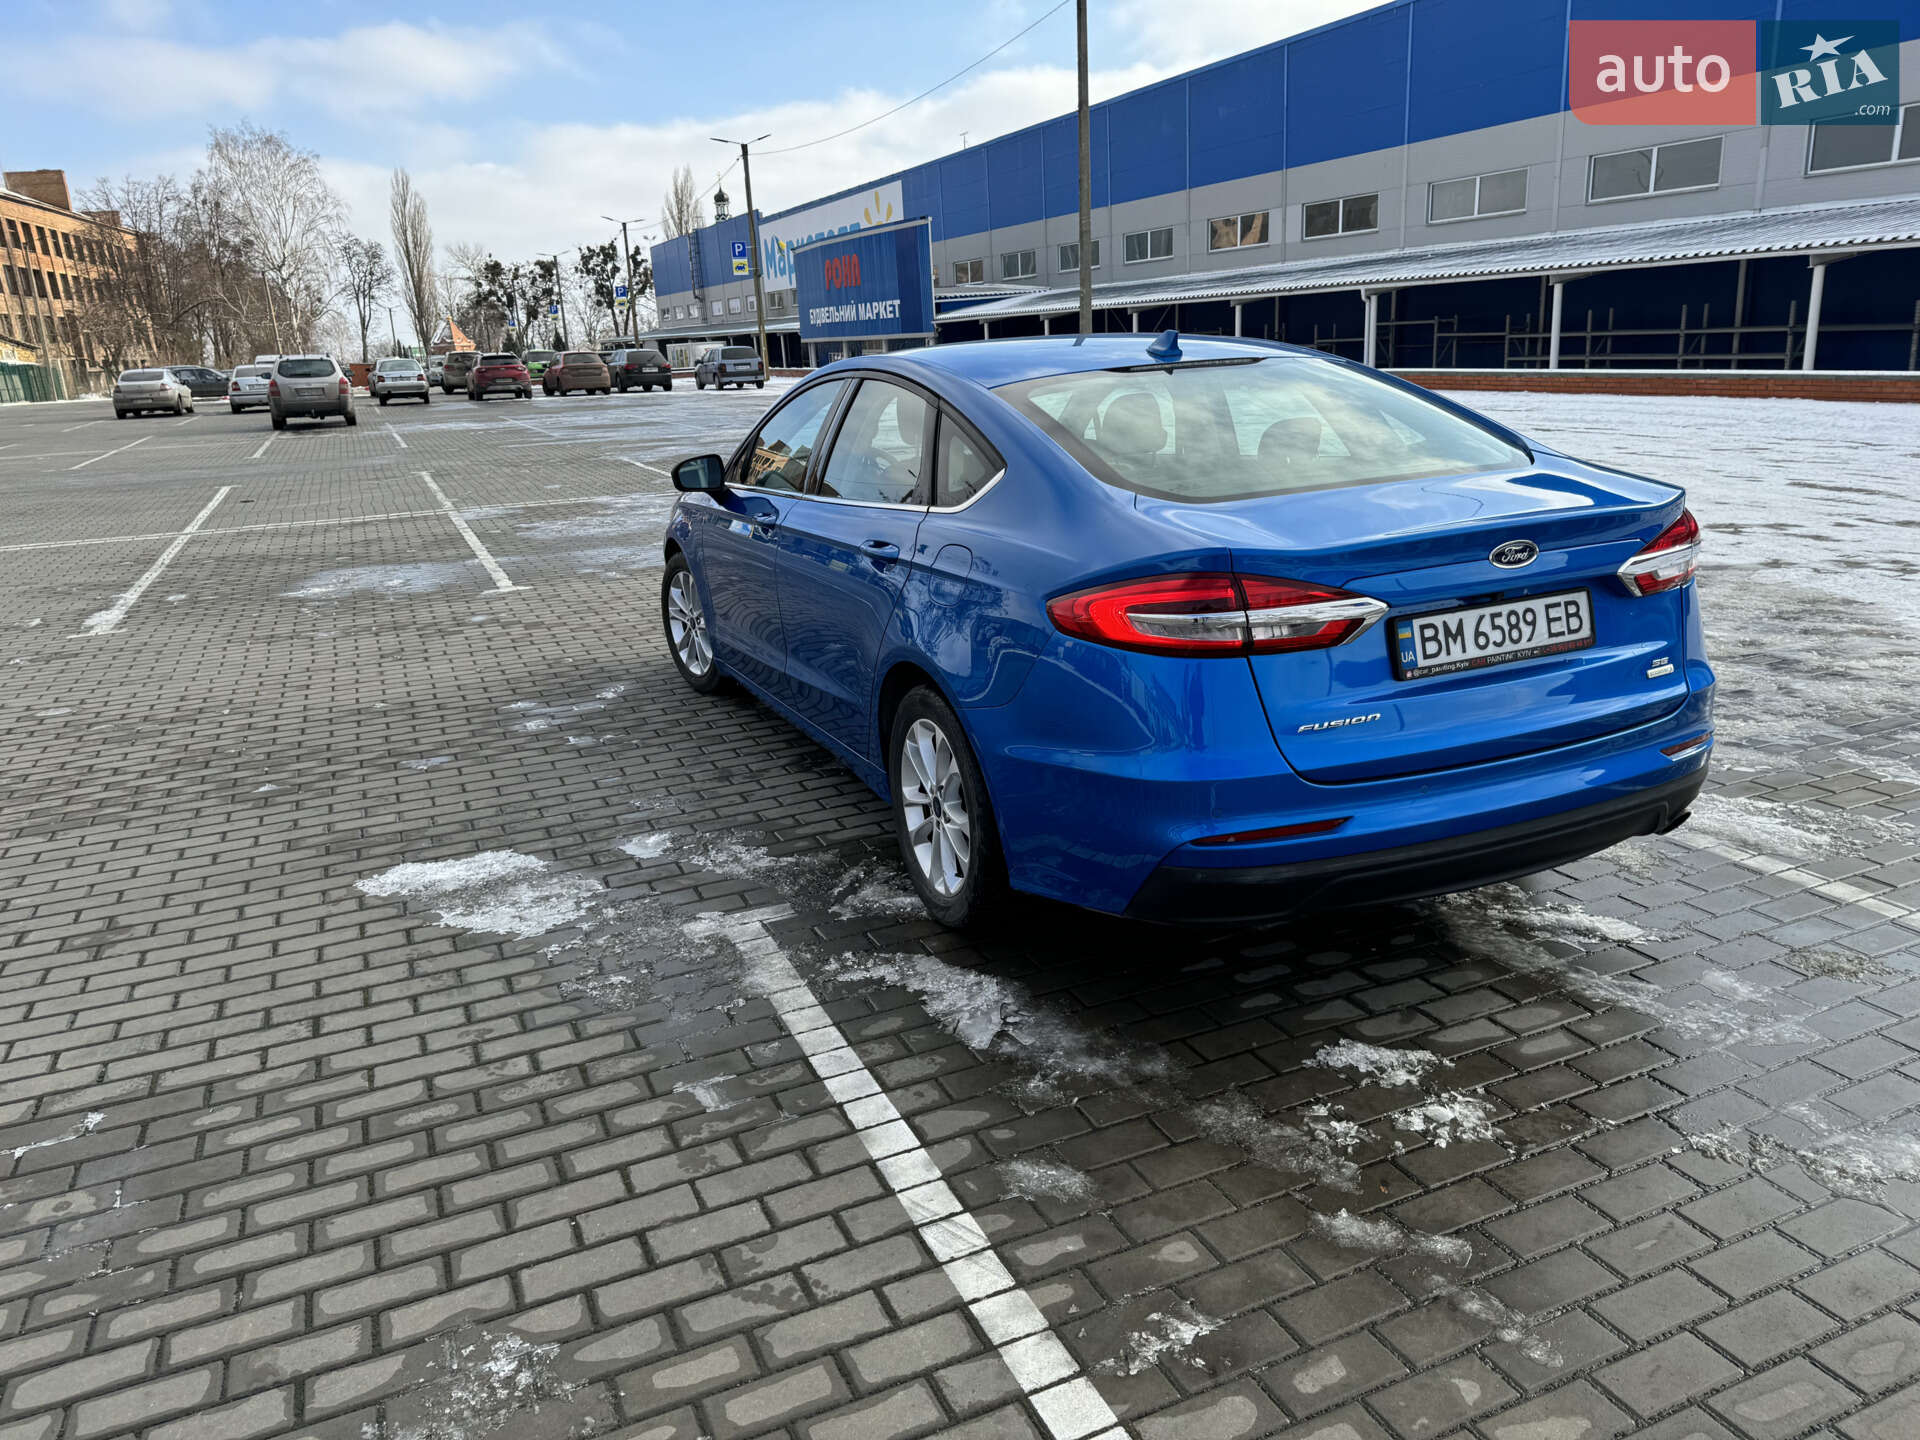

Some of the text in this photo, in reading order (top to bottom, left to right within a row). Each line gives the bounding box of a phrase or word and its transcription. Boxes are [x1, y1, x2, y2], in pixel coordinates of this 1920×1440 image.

[734, 243, 743, 256] P
[858, 299, 901, 321] МАРКЕТ
[1502, 545, 1529, 563] Ford
[1419, 600, 1584, 660] BM 6589 EB
[1401, 651, 1416, 663] UA
[1297, 713, 1382, 733] FUSION
